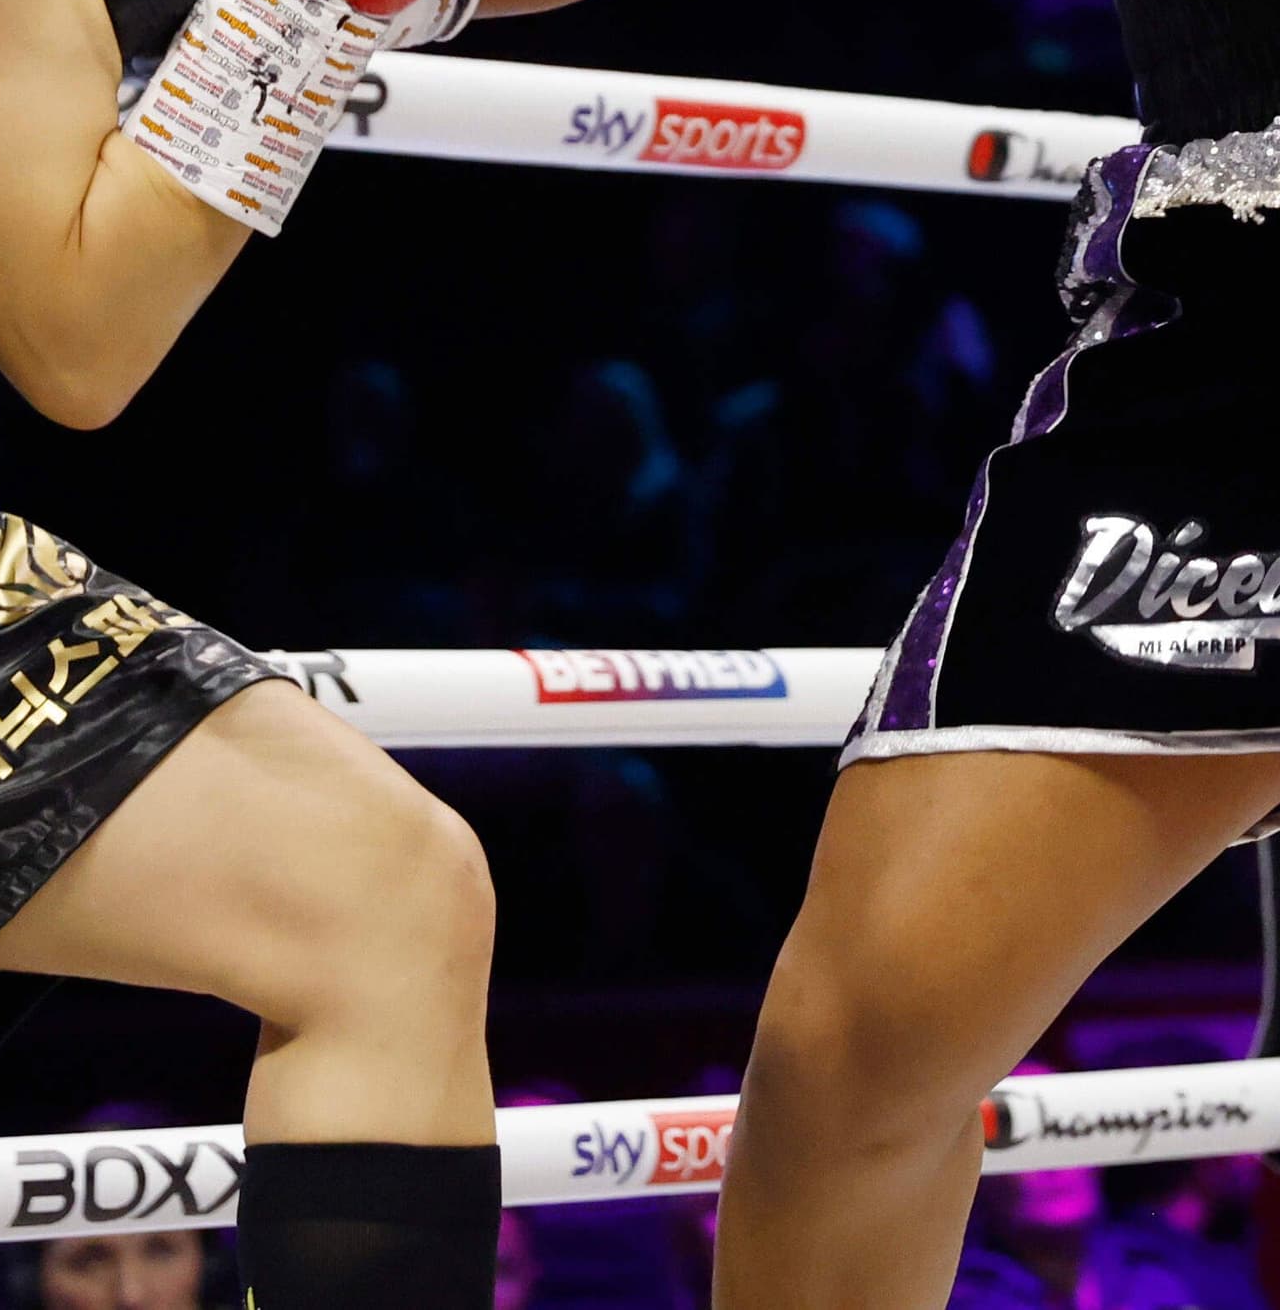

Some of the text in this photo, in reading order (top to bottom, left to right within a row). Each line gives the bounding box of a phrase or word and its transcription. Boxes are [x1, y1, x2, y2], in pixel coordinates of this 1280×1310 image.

[562, 93, 801, 166] sky sports
[1197, 637, 1248, 654] PREP
[571, 1121, 646, 1186] sky
[978, 1090, 1250, 1155] Champion
